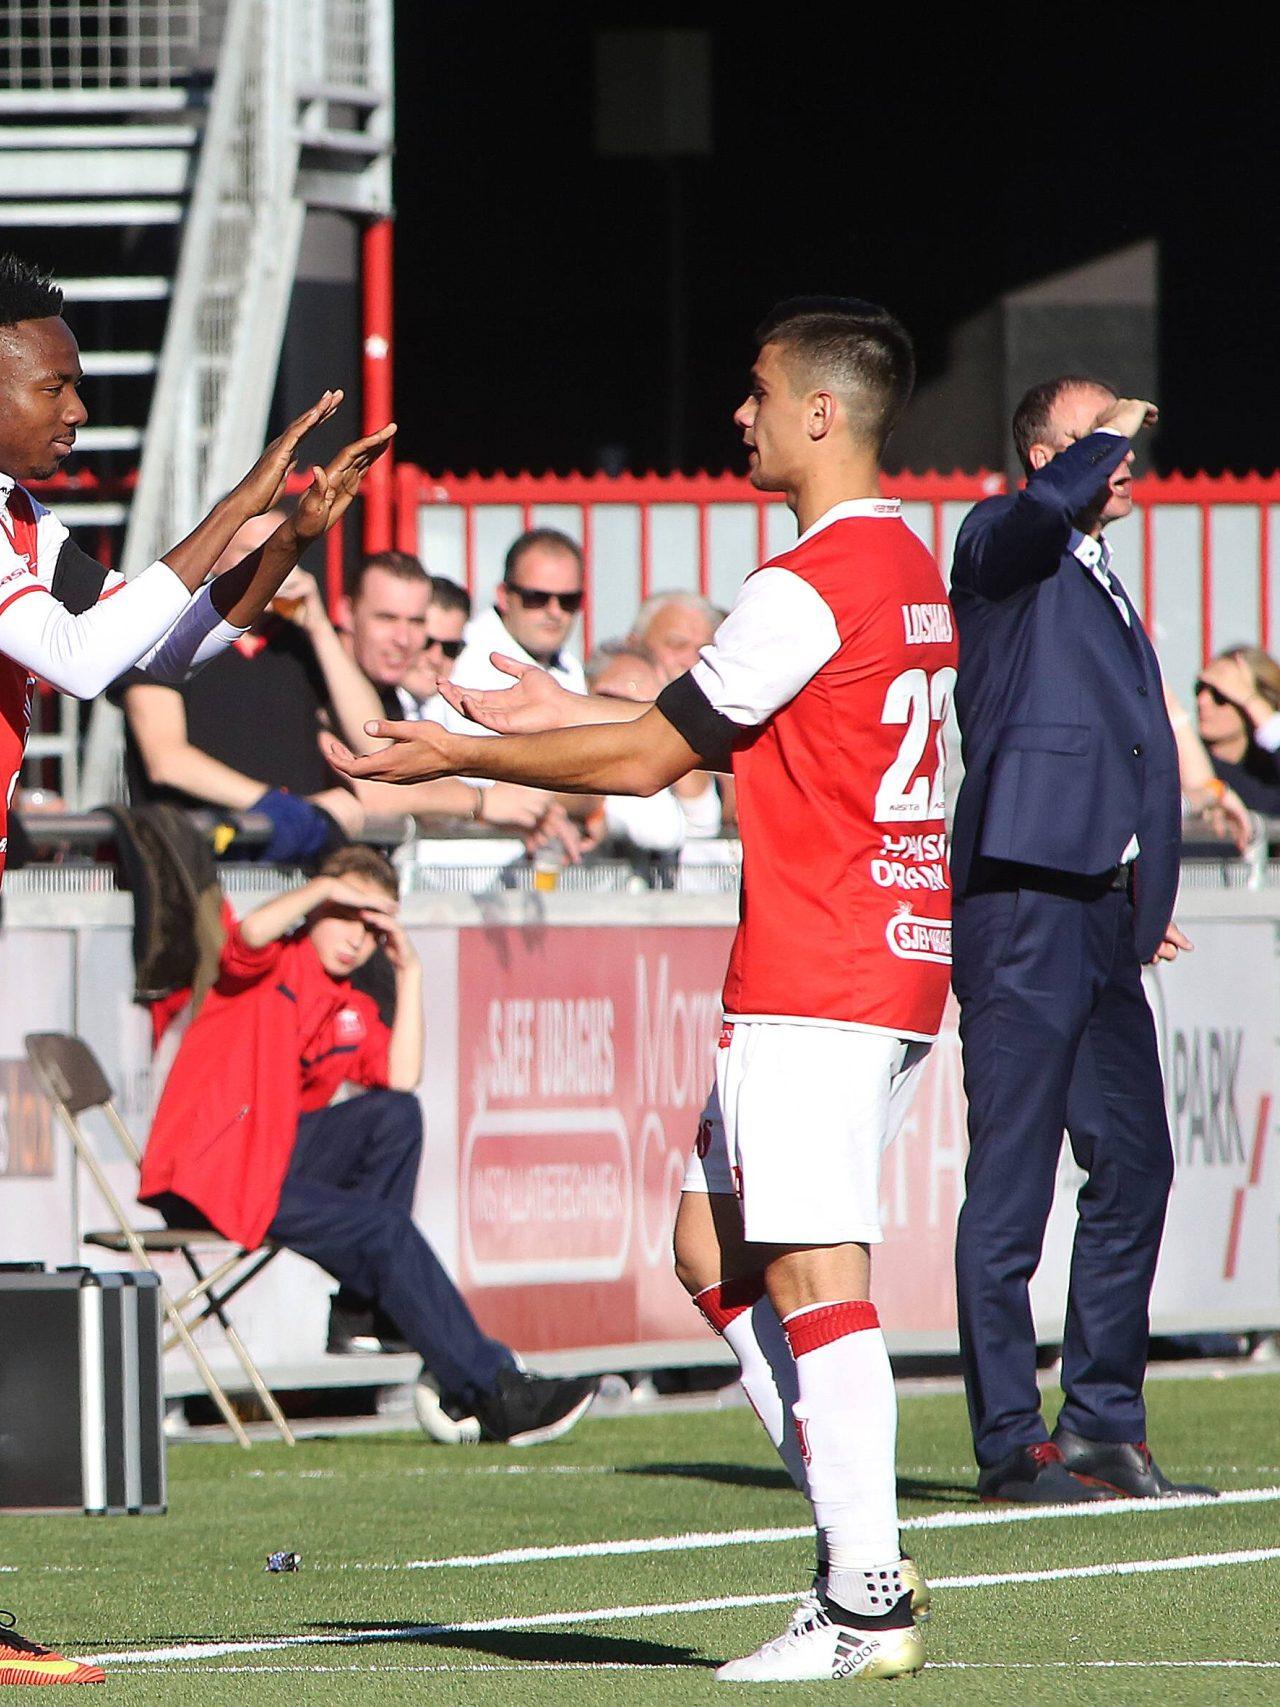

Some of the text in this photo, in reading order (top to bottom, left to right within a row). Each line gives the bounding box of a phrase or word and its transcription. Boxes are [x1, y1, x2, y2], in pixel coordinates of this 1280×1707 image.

[488, 997, 535, 1097] SJEF
[1171, 1028, 1247, 1166] PARK
[831, 1640, 881, 1680] adidas
